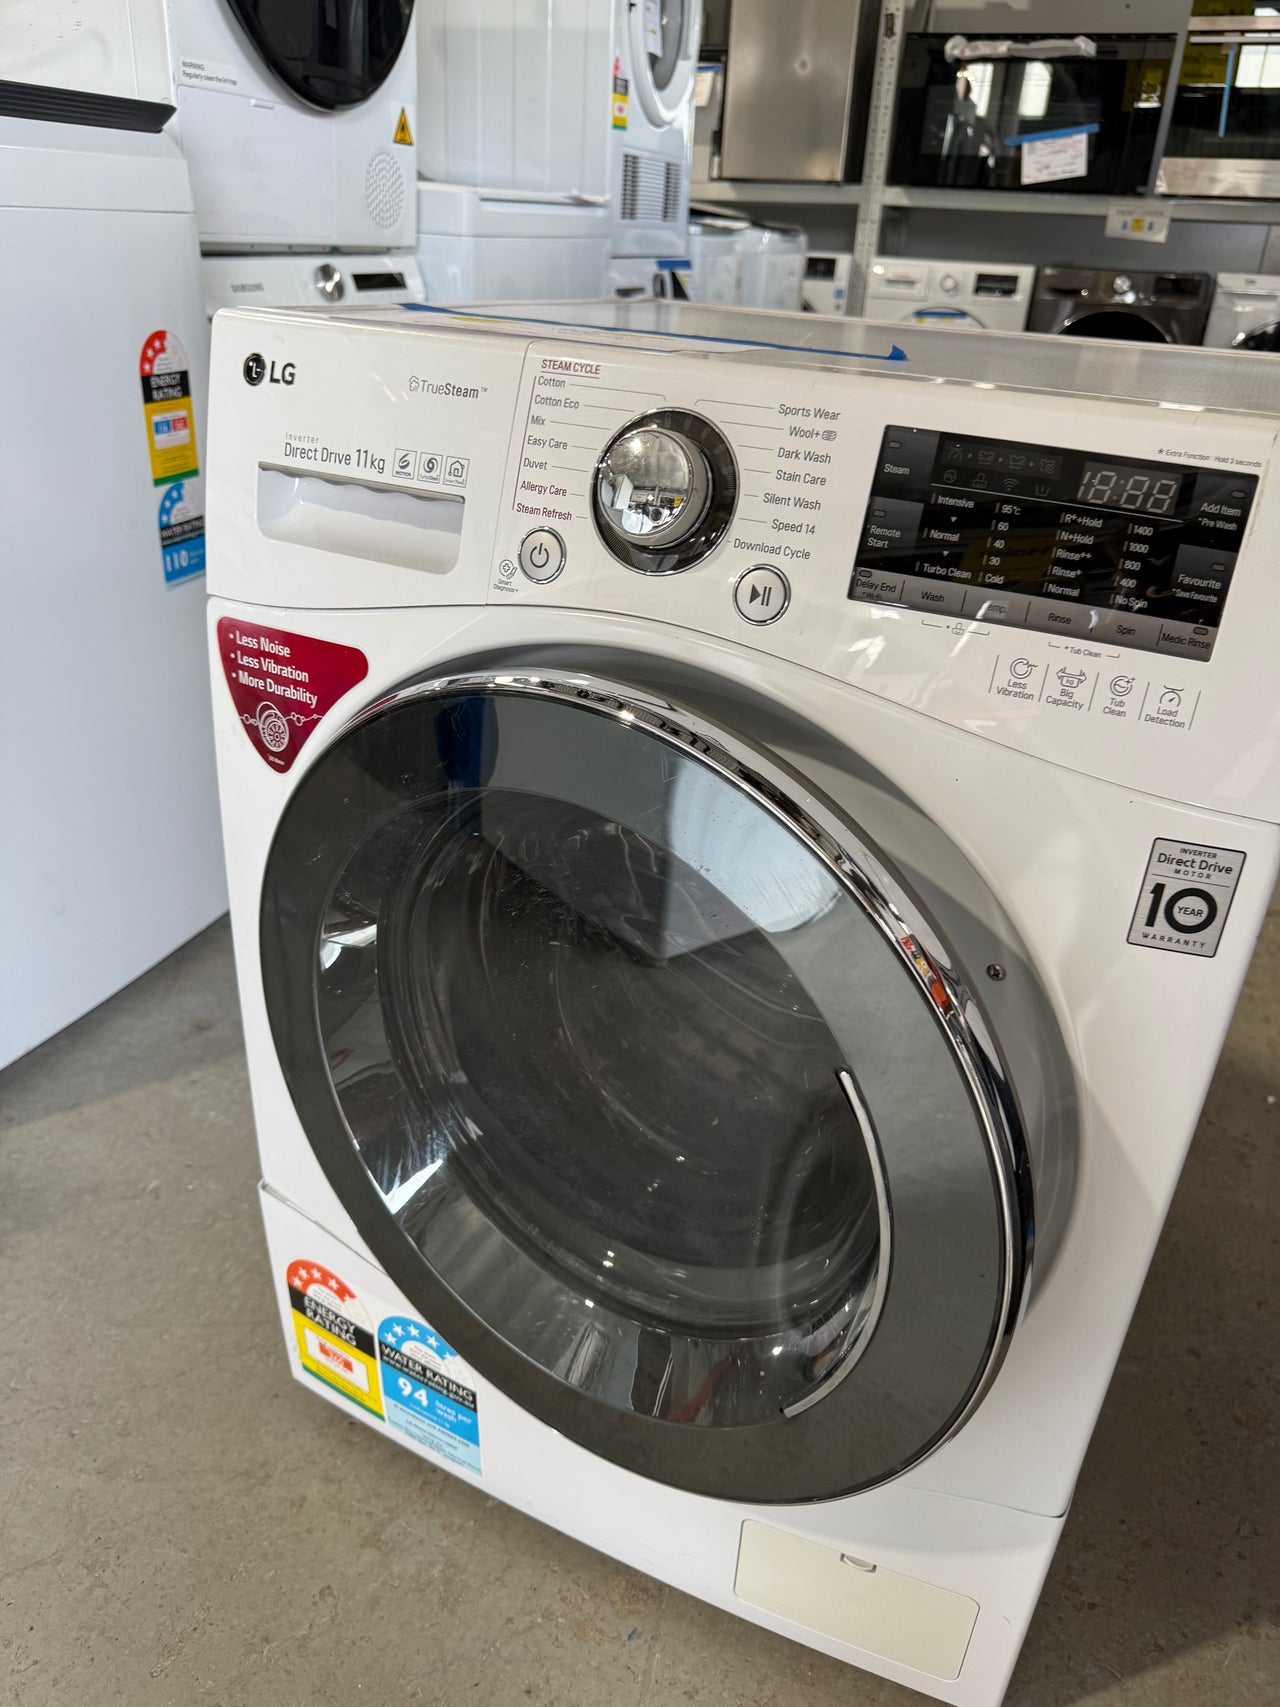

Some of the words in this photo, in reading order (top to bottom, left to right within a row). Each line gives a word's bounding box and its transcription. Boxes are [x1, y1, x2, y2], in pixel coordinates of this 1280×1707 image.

[269, 360, 297, 386] LG
[541, 359, 572, 373] STEAM
[573, 362, 601, 376] CYCLE
[537, 375, 566, 388] Cotton
[534, 394, 562, 408] Cotton
[563, 398, 580, 410] Eco
[778, 403, 811, 419] Sports
[813, 407, 841, 421] Wear
[530, 414, 546, 426] Mix
[285, 432, 320, 444] Inverter
[788, 425, 821, 439] Wool+
[527, 435, 547, 450] Easy
[548, 438, 568, 450] Care
[284, 443, 319, 462] Direct
[321, 447, 352, 466] Drive
[356, 449, 386, 474] 11kg
[777, 447, 802, 460] Dark
[803, 451, 832, 464] Wash
[1165, 449, 1182, 458] Extra
[1183, 451, 1211, 461] Function
[1214, 455, 1229, 464] Hold
[1235, 459, 1262, 468] seconds
[523, 458, 548, 471] Duvet
[883, 463, 911, 476] Steam
[775, 469, 801, 483] Stain
[803, 473, 827, 486] Care
[519, 481, 549, 497] Allergy
[549, 485, 568, 497] Care
[763, 493, 791, 507] Silent
[793, 497, 821, 511] Wash
[937, 495, 975, 509] Intensive
[1200, 502, 1220, 514] Add
[1221, 505, 1241, 517] Item
[516, 503, 542, 517] Steam
[542, 507, 573, 521] Refresh
[771, 518, 804, 535] Speed
[805, 523, 816, 535] 14
[870, 525, 902, 538] Remote
[997, 522, 1009, 531] 60
[1133, 525, 1154, 536] 1400
[1201, 518, 1215, 528] Pre
[1216, 520, 1238, 531] Wash
[867, 537, 889, 549] Start
[930, 529, 960, 542] Normal
[1060, 531, 1095, 545] N+Hold
[733, 538, 781, 556] Download
[783, 545, 811, 560] Cycle
[993, 539, 1005, 549] 40
[1129, 542, 1149, 554] 1000
[165, 549, 190, 573] 110
[989, 556, 1000, 566] 30
[1123, 560, 1141, 571] 800
[923, 562, 947, 576] Turbo
[948, 568, 973, 580] Clean
[855, 578, 880, 592] Delay
[880, 582, 897, 593] End
[985, 573, 1005, 585] Cold
[1120, 578, 1137, 588] 400
[1178, 574, 1222, 590] Favourite
[921, 590, 945, 603] Wash
[1047, 583, 1080, 597] Normal
[1175, 588, 1190, 599] Save
[1190, 591, 1218, 603] Favourite
[985, 601, 1009, 615] emp.
[1114, 594, 1128, 605] No
[1128, 597, 1148, 609] Spin
[1047, 612, 1072, 625] Rinse
[1115, 624, 1136, 637] Spin
[235, 630, 259, 649] Less
[260, 636, 291, 658] Noise
[1161, 633, 1187, 647] Medic
[1187, 637, 1212, 651] Rinse
[1070, 646, 1083, 656] Tub
[1083, 648, 1102, 658] Clean
[236, 650, 260, 669] Less
[260, 657, 309, 683] Vibration
[237, 669, 265, 690] More
[266, 679, 318, 709] Durability
[1006, 678, 1028, 690] Less
[996, 686, 1034, 701] Vibration
[1059, 688, 1075, 700] Big
[1045, 695, 1085, 711] Capacity
[1109, 697, 1126, 708] Tub
[1102, 705, 1127, 718] Clean
[1156, 706, 1178, 718] Load
[1144, 714, 1186, 729] Detection
[1179, 847, 1218, 859] INVERTER
[1157, 852, 1197, 869] Direct
[1198, 859, 1234, 875] Drive
[1174, 868, 1212, 880] MOTOR
[1144, 882, 1218, 935] 10
[1177, 905, 1204, 918] YEAR
[1141, 931, 1206, 949] WARRANTY
[303, 1295, 356, 1334] ENERGY
[305, 1307, 357, 1347] RATING
[381, 1343, 424, 1375] WATER
[426, 1368, 474, 1401] RATING
[397, 1377, 429, 1408] 94
